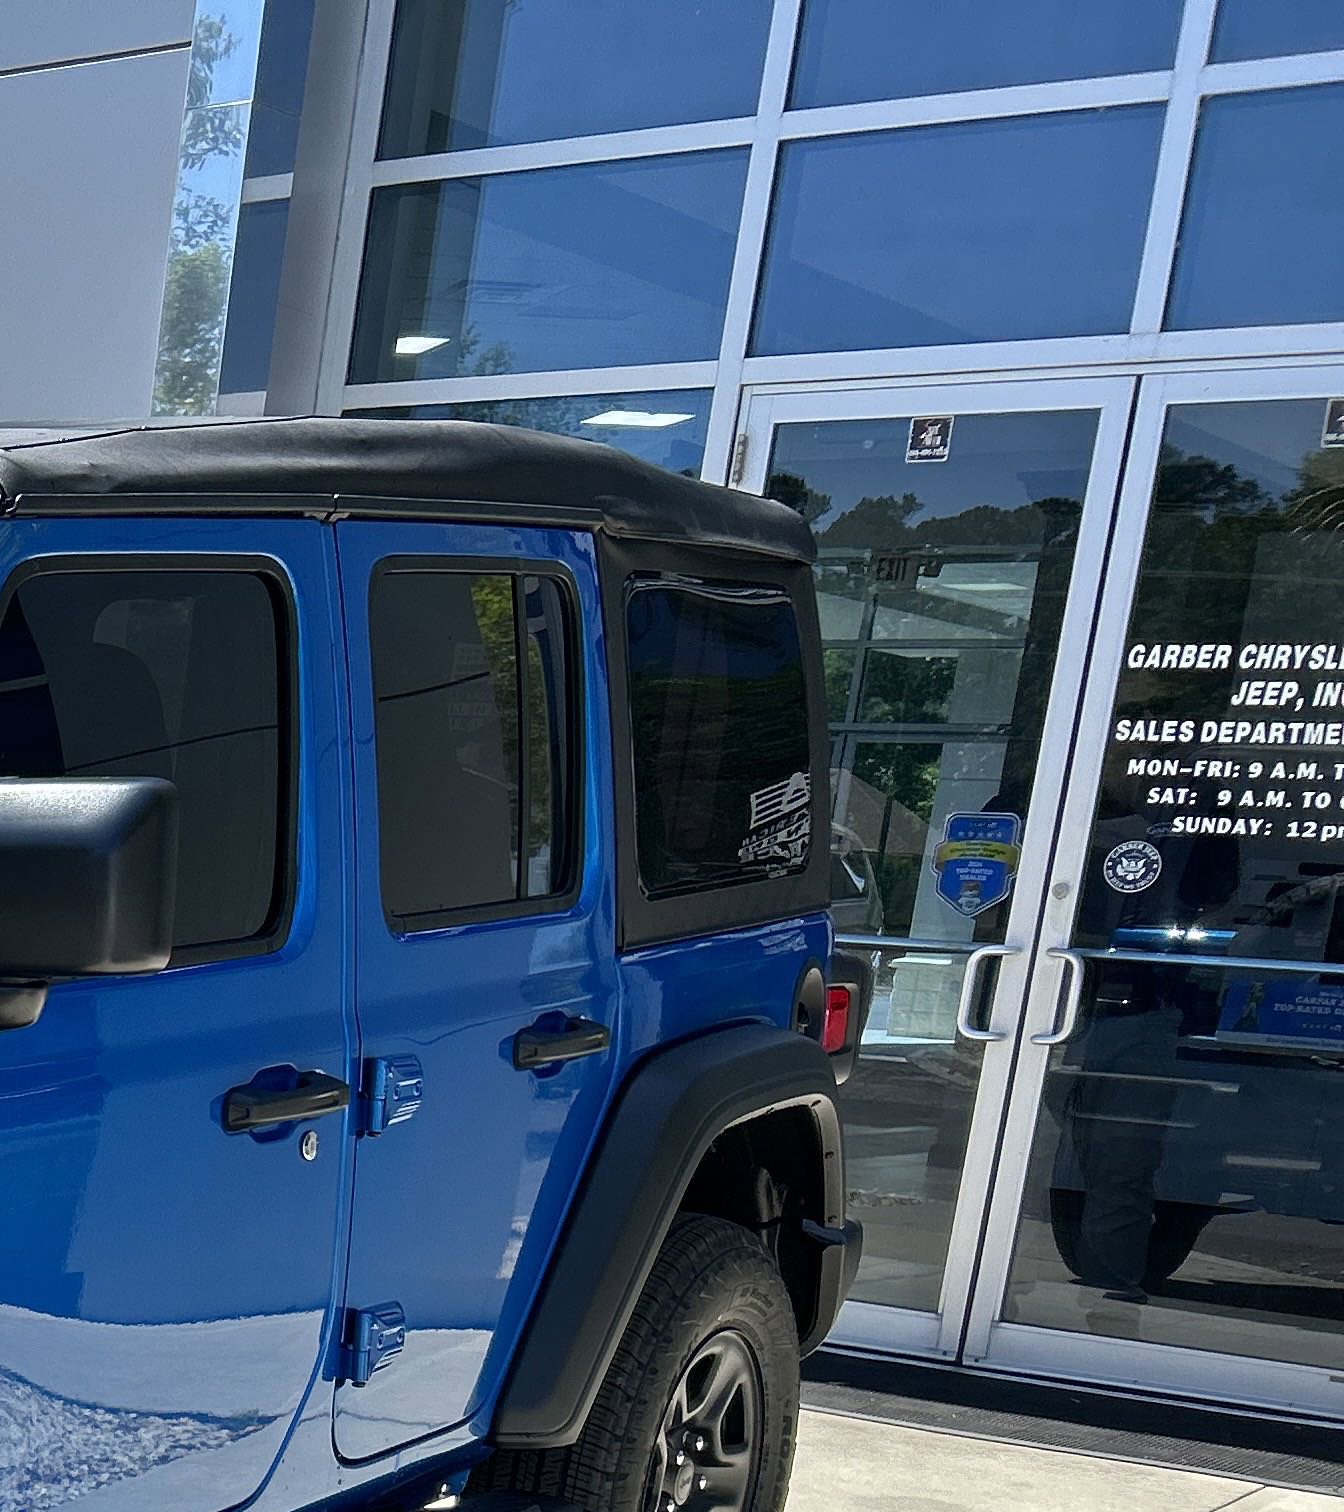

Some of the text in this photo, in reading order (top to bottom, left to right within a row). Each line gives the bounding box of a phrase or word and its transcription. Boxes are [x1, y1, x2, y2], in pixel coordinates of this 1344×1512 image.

[1127, 644, 1233, 669] GARBER
[1231, 681, 1305, 712] JEEP,
[1115, 719, 1344, 745] SALES DEPARTME
[1248, 762, 1264, 778] 9
[1269, 762, 1325, 780] A.M.
[1147, 787, 1199, 805] SAT:
[1217, 790, 1233, 806] 9
[1239, 790, 1293, 808] A.M.
[1302, 792, 1331, 809] TO
[1171, 816, 1273, 836] SUNDAY:
